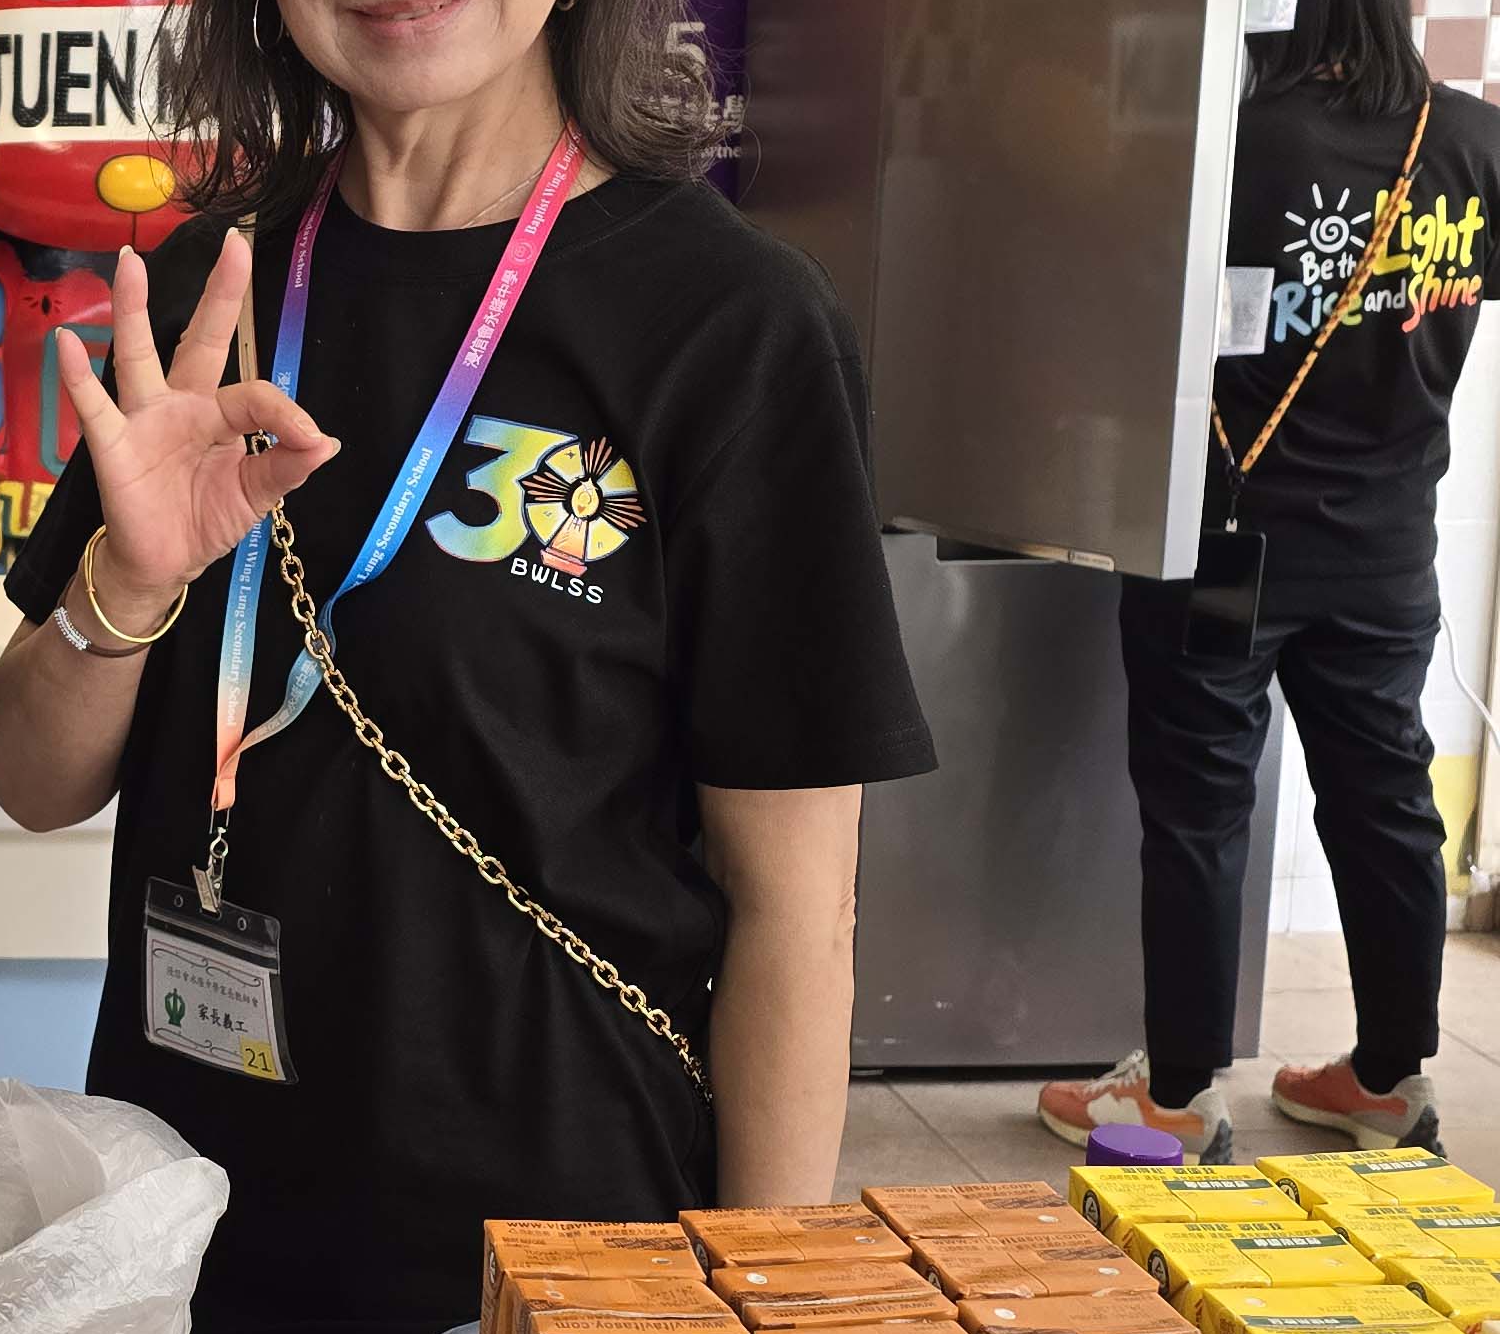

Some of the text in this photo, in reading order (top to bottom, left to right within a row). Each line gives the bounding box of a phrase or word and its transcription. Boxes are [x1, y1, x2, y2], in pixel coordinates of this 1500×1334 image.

[524, 196, 554, 237] Baptist
[542, 168, 567, 199] Wing
[555, 140, 580, 171] Lung
[295, 251, 307, 288] School
[1299, 251, 1334, 287] Be
[1372, 189, 1485, 276] Light
[461, 267, 521, 371] 浸信會永隆中學
[1364, 277, 1406, 313] and
[357, 446, 434, 581] Lung Secondary School
[510, 557, 604, 604] BWLSS
[227, 522, 262, 726] ptist Wing Lung Secondary School
[198, 1003, 248, 1033] 家長義工
[245, 1048, 273, 1073] 21
